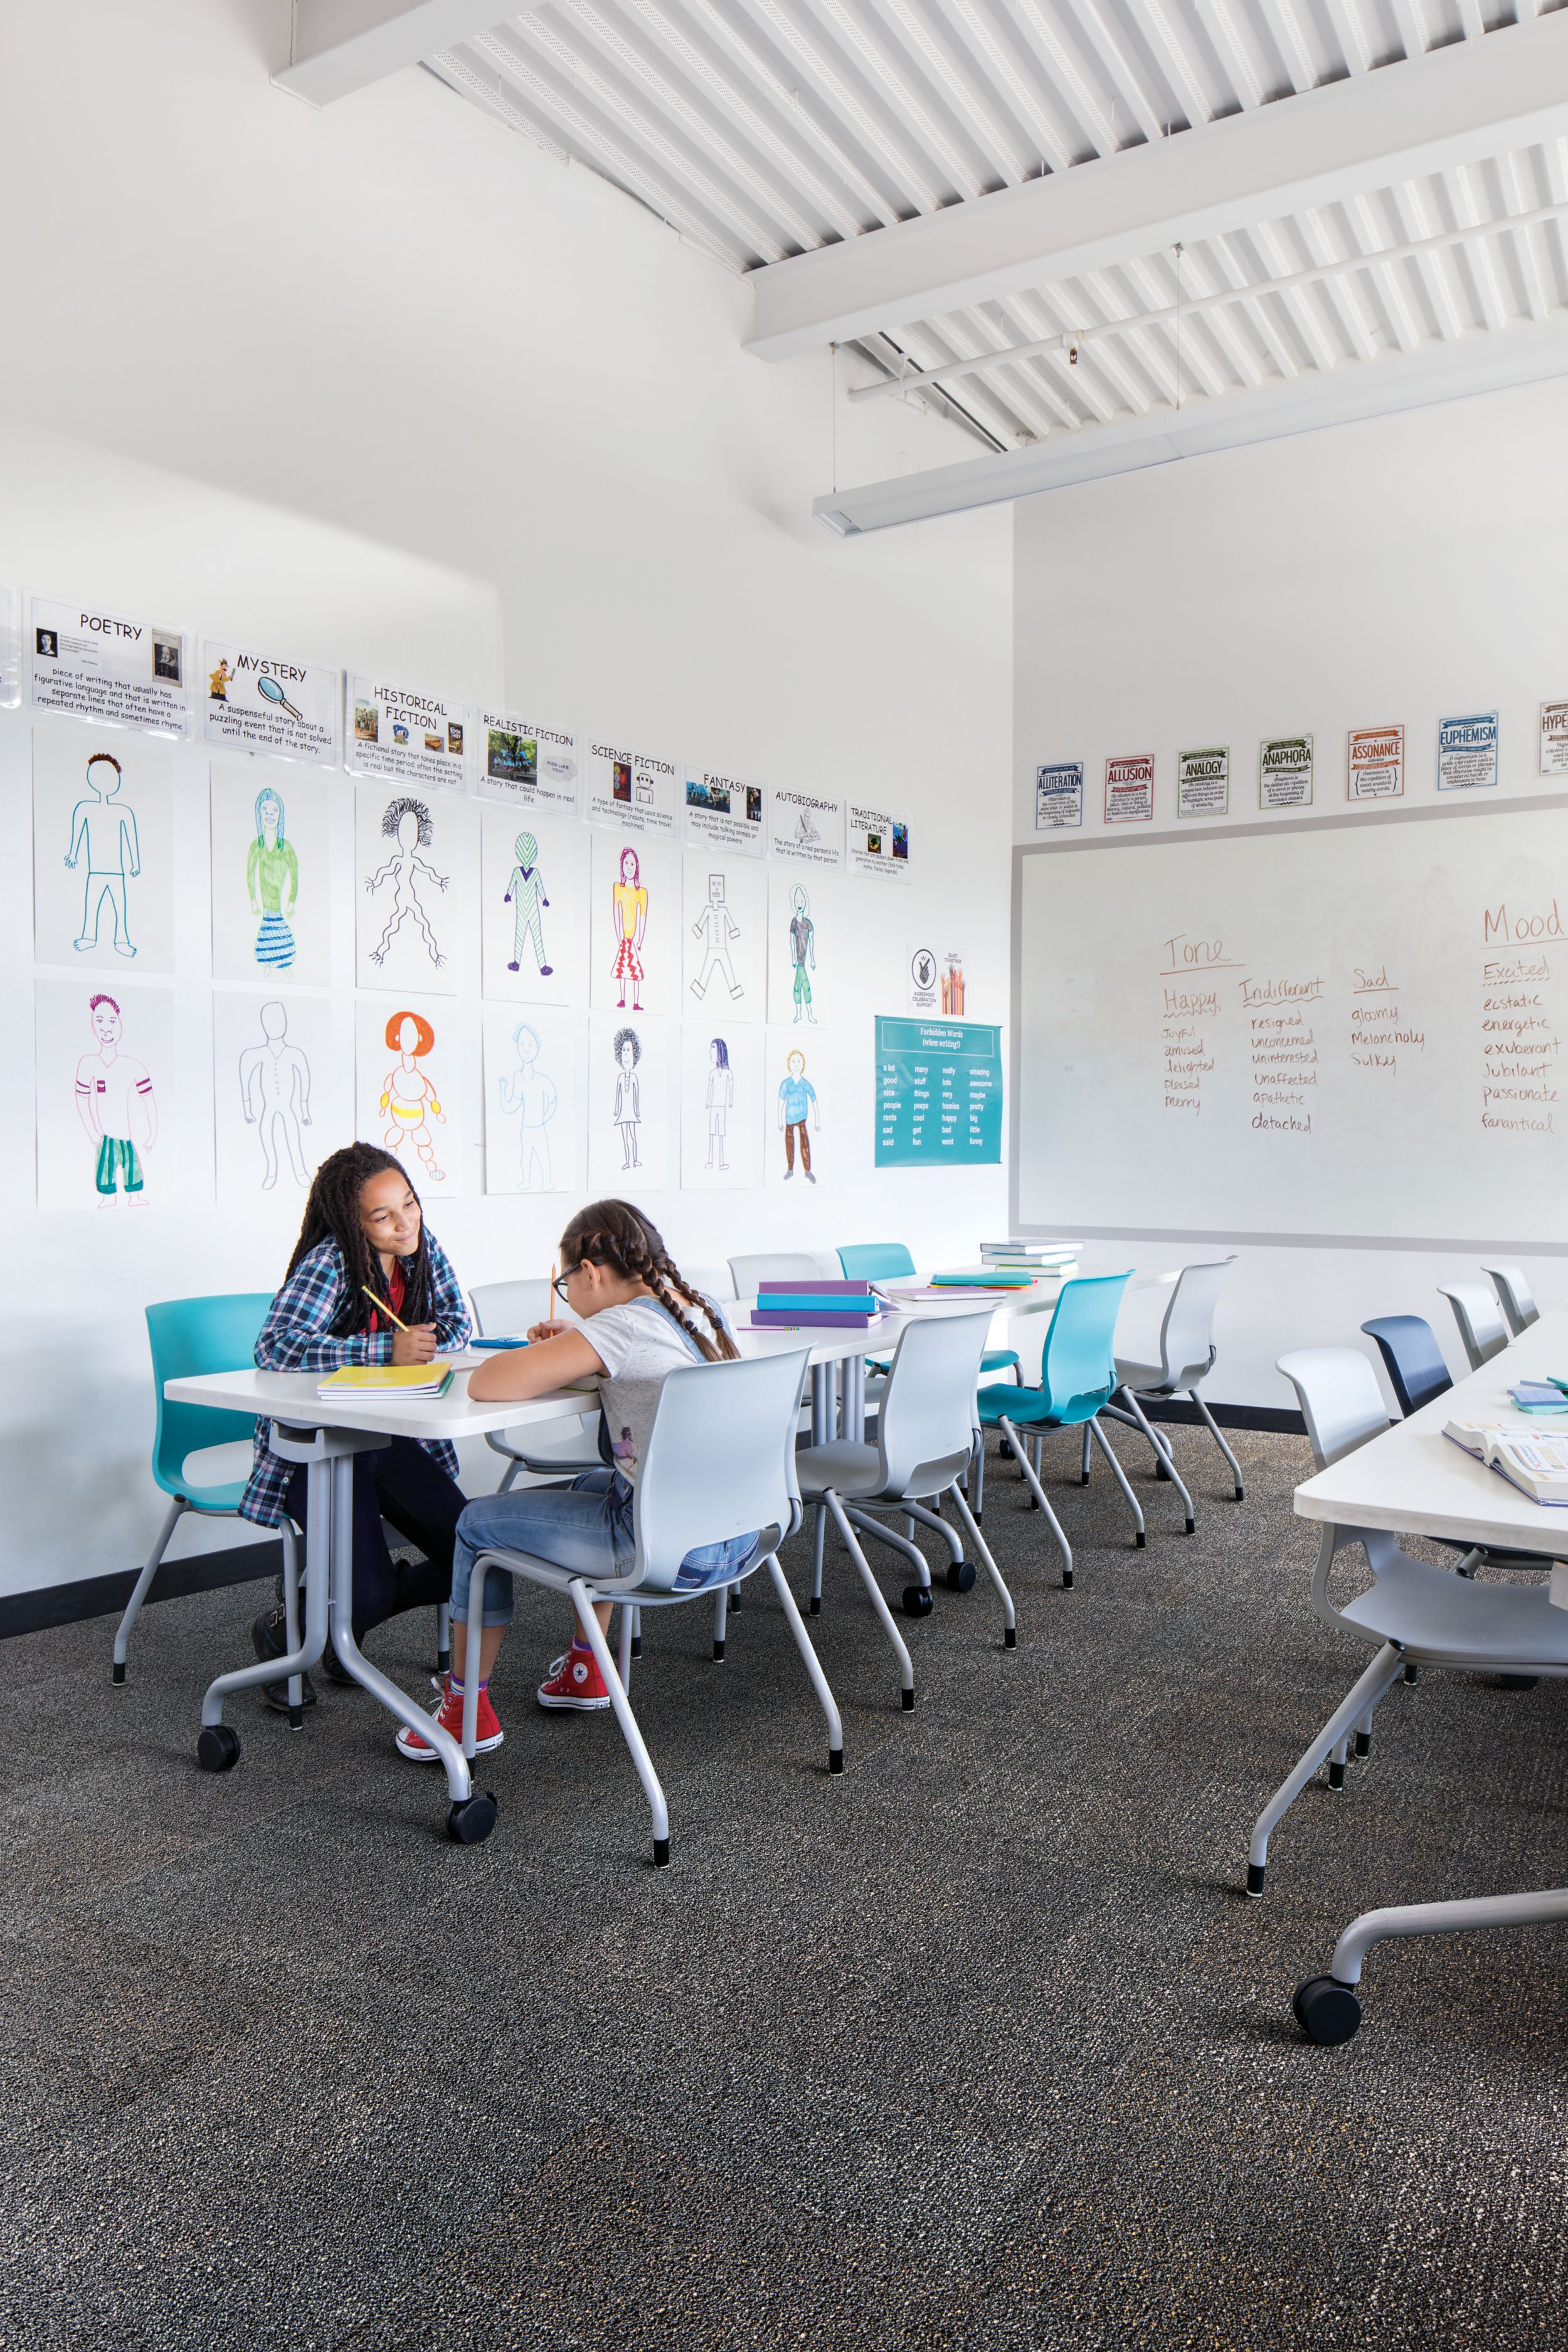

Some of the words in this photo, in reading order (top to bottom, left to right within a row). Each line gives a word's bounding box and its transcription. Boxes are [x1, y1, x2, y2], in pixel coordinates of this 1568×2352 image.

[80, 614, 142, 640] POETRY
[238, 655, 306, 682] MYSTERY
[34, 672, 73, 688] figurative
[75, 681, 107, 698] language
[109, 689, 123, 698] and
[125, 691, 140, 702] that
[143, 695, 150, 704] is
[152, 698, 178, 709] written
[179, 702, 186, 711] in
[75, 672, 83, 681] of
[85, 675, 112, 689] writing
[114, 679, 130, 691] that
[159, 688, 172, 699] has
[51, 688, 86, 701] separate
[88, 693, 105, 705] lines
[108, 697, 124, 709] that
[125, 701, 147, 713] often
[148, 705, 165, 716] have
[374, 686, 447, 716] HISTORICAL
[38, 696, 74, 709] repeated
[77, 702, 104, 714] rhythm
[105, 708, 119, 718] and
[120, 712, 159, 725] sometimes
[162, 718, 183, 731] rhyme
[219, 702, 225, 711] A
[227, 706, 273, 721] suspenseful
[275, 716, 295, 730] story
[297, 720, 317, 731] about
[386, 706, 437, 729] FICTION
[1543, 714, 1568, 730] HYPE
[209, 712, 242, 729] puzzling
[245, 720, 266, 730] event
[268, 723, 285, 734] that
[287, 727, 294, 736] is
[296, 731, 307, 739] not
[309, 733, 332, 744] solved
[484, 715, 533, 735] REALISTIC
[536, 728, 573, 746] FICTION
[1441, 726, 1496, 745] EUPHEMISM
[222, 726, 240, 736] until
[243, 729, 257, 739] the
[258, 734, 273, 742] end
[275, 736, 283, 744] of
[286, 738, 298, 747] the
[300, 741, 321, 756] story.
[1352, 741, 1400, 760] ASSONANCE
[365, 743, 389, 754] fictional
[391, 749, 406, 761] story
[408, 752, 420, 760] that
[420, 755, 436, 764] takes
[437, 758, 451, 768] place
[591, 745, 632, 765] SCIENCE
[635, 756, 674, 775] FICTION
[1263, 749, 1311, 766] ANAPHORA
[1108, 766, 1152, 782] ALLUSION
[1185, 761, 1222, 776] ANALOGY
[487, 778, 503, 790] story
[504, 781, 517, 790] that
[537, 788, 556, 800] happen
[704, 774, 745, 793] FANTASY
[1039, 774, 1081, 790] ALLITERATION
[524, 795, 534, 803] life
[776, 792, 837, 812] AUTOBIOGRAPHY
[851, 807, 893, 825] TRADITIONAL
[851, 819, 887, 835] LITERATURE
[1485, 898, 1565, 943] Mood
[1163, 934, 1231, 967] Tone
[1353, 965, 1389, 989] Sad
[1484, 955, 1550, 980] Excited
[1239, 976, 1325, 1002] Indifferent
[1164, 988, 1217, 1017] Happy
[1484, 994, 1544, 1011] ecstatic
[1251, 1009, 1303, 1034] resigned
[1351, 1006, 1399, 1028] gloomy
[1481, 1016, 1550, 1037] energetic
[920, 1028, 946, 1037] Forbidden
[948, 1030, 963, 1038] Words
[923, 1039, 938, 1047] (when
[940, 1040, 960, 1049] writing!)
[1164, 1038, 1205, 1057] amused
[1484, 1037, 1564, 1055] exuberant
[1253, 1049, 1319, 1064] uninterested
[914, 1067, 928, 1075] many
[943, 1067, 956, 1076] really
[970, 1069, 990, 1077] amazing
[884, 1077, 898, 1085] good
[1164, 1078, 1200, 1094] pleased
[914, 1090, 930, 1098] things
[970, 1092, 986, 1100] maybe
[1253, 1091, 1306, 1108] apathetic
[1483, 1084, 1559, 1106] passionate
[884, 1102, 901, 1110] people
[942, 1115, 957, 1123] happy
[970, 1115, 978, 1123] big
[1252, 1111, 1311, 1135] detached
[970, 1138, 983, 1147] funny
